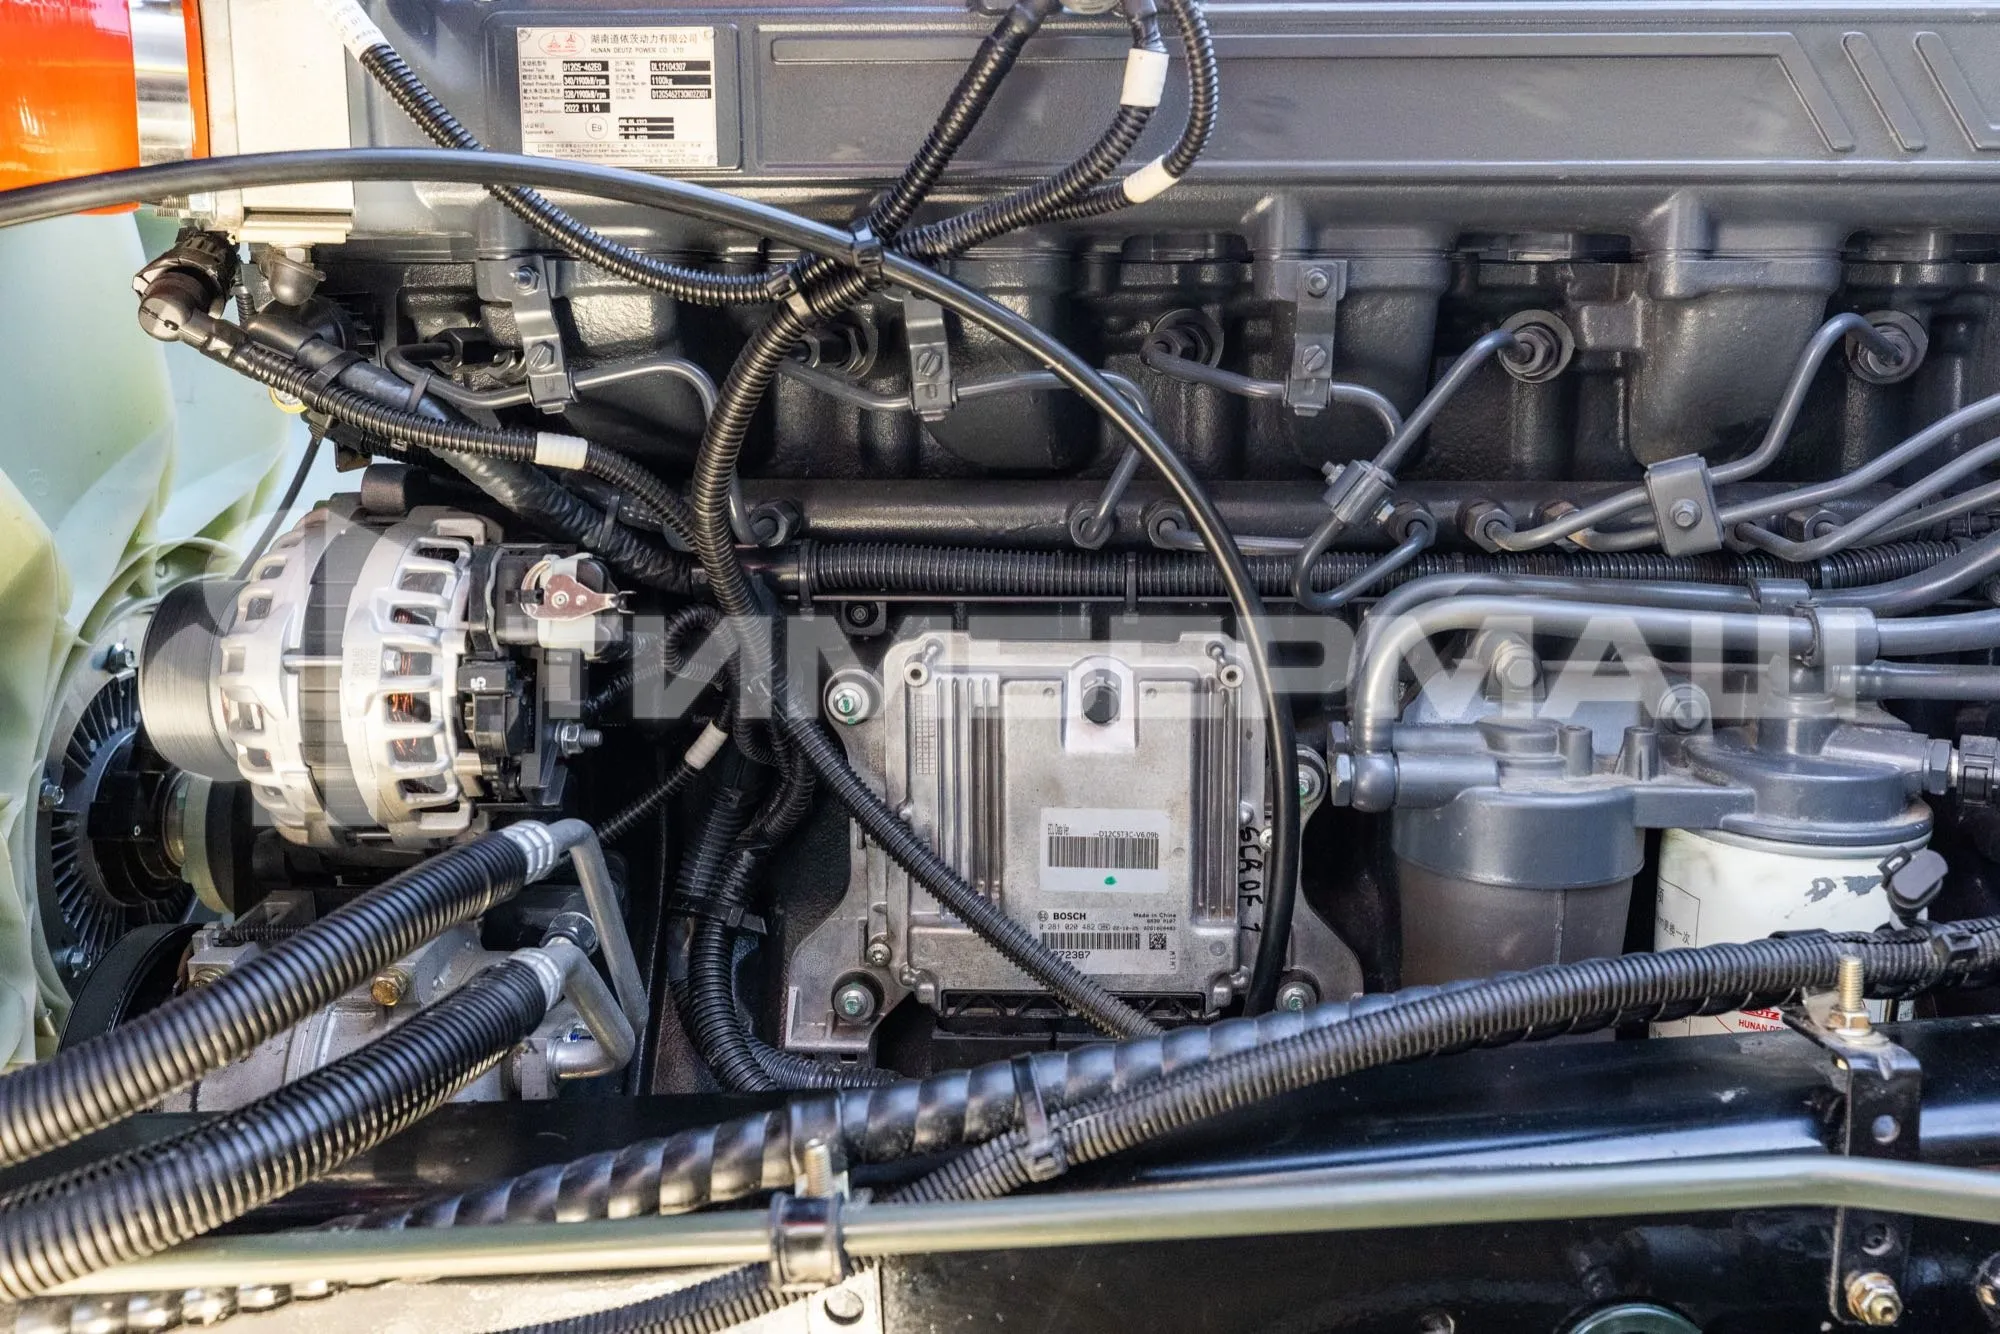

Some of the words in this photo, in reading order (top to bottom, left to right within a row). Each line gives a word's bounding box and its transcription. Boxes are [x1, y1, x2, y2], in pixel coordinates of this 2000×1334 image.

[565, 103, 580, 112] 2022
[582, 103, 590, 112] 11
[592, 103, 601, 112] 14
[1053, 912, 1087, 920] BOSCH
[1738, 1019, 1768, 1032] HUNAN
